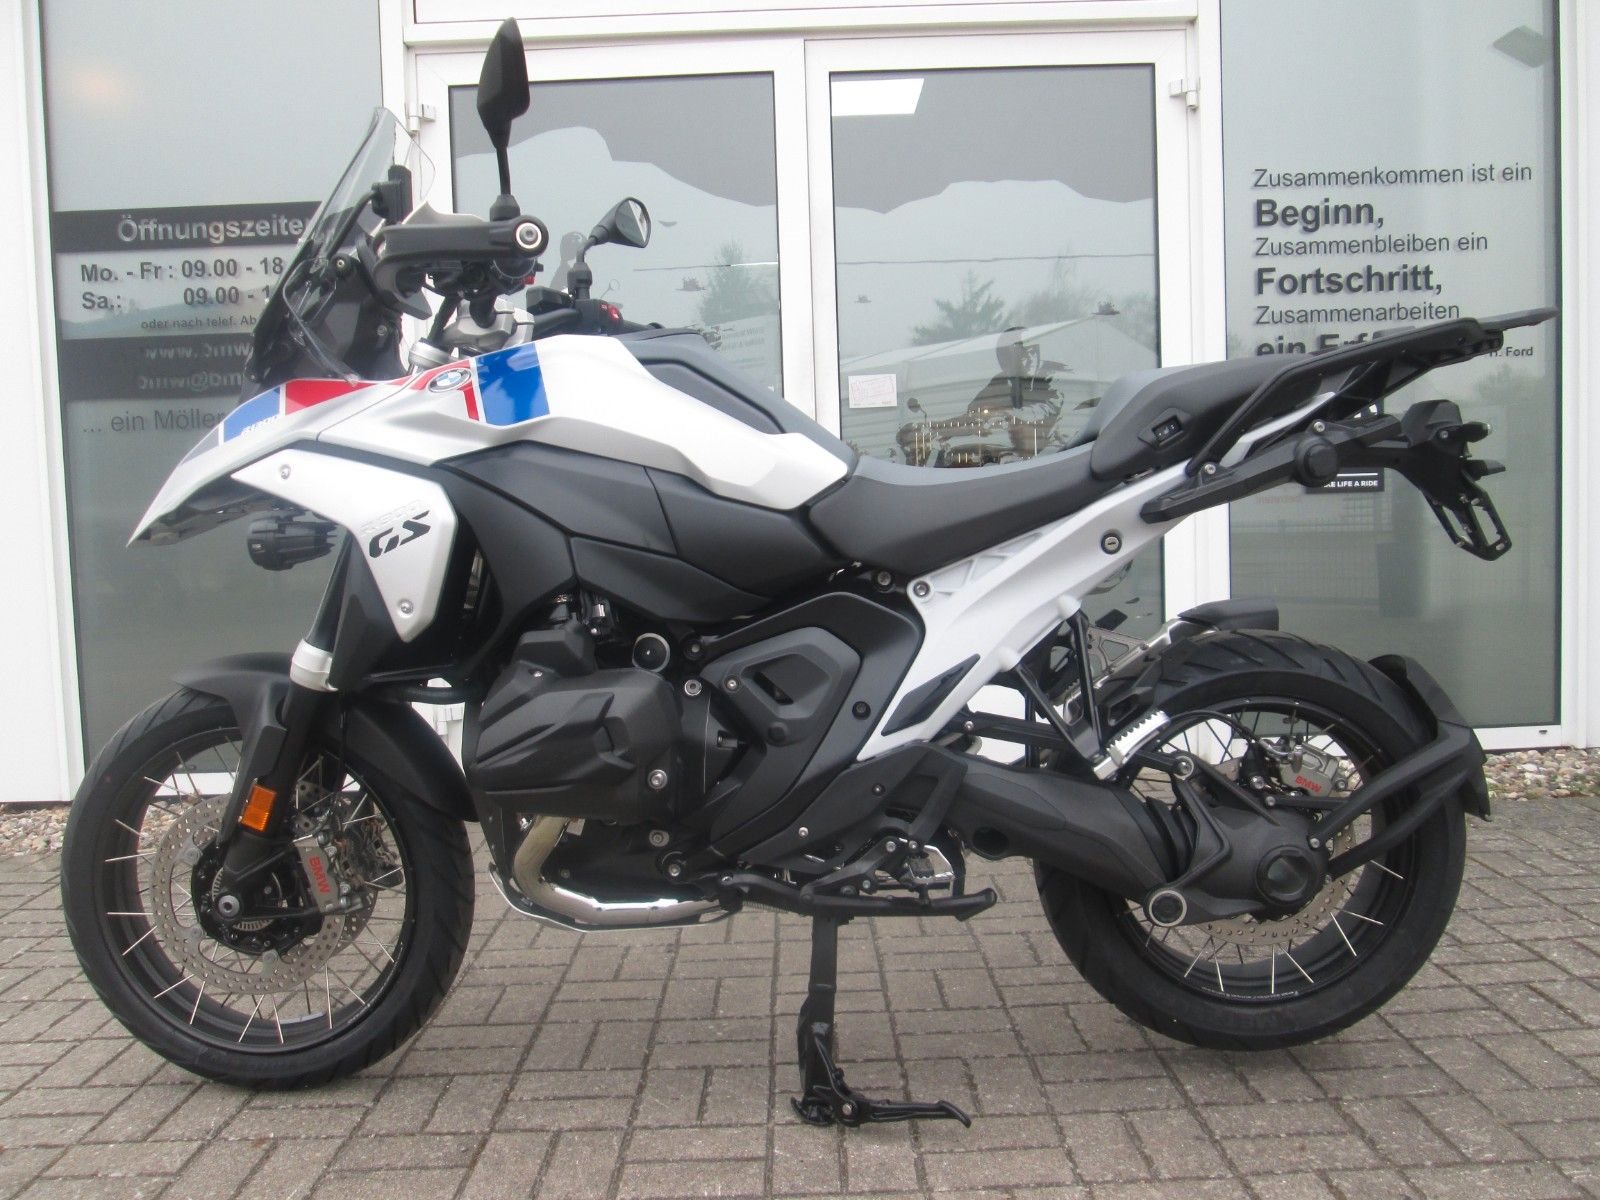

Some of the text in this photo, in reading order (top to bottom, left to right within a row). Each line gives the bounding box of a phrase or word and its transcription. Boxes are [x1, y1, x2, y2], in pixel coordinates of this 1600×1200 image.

[1254, 162, 1532, 188] Zusammenkommen ist ein
[1255, 197, 1384, 233] Beginn,
[1255, 232, 1488, 257] Zusammenbleiben ein
[81, 263, 119, 283] Mo.
[140, 261, 162, 280] Fr
[181, 258, 238, 278] 09.00
[260, 256, 284, 275] 18
[1256, 264, 1443, 296] Fortschritt,
[183, 286, 240, 306] 09.00
[140, 319, 168, 329] oder
[173, 317, 203, 328] nach
[1255, 301, 1461, 325] Zusammenarbeiten
[1256, 335, 1307, 356] ein
[1505, 346, 1534, 357] Ford
[111, 411, 145, 432] ein
[1337, 480, 1353, 488] LIFE
[1295, 775, 1322, 793] BMW
[308, 855, 331, 893] BMW
